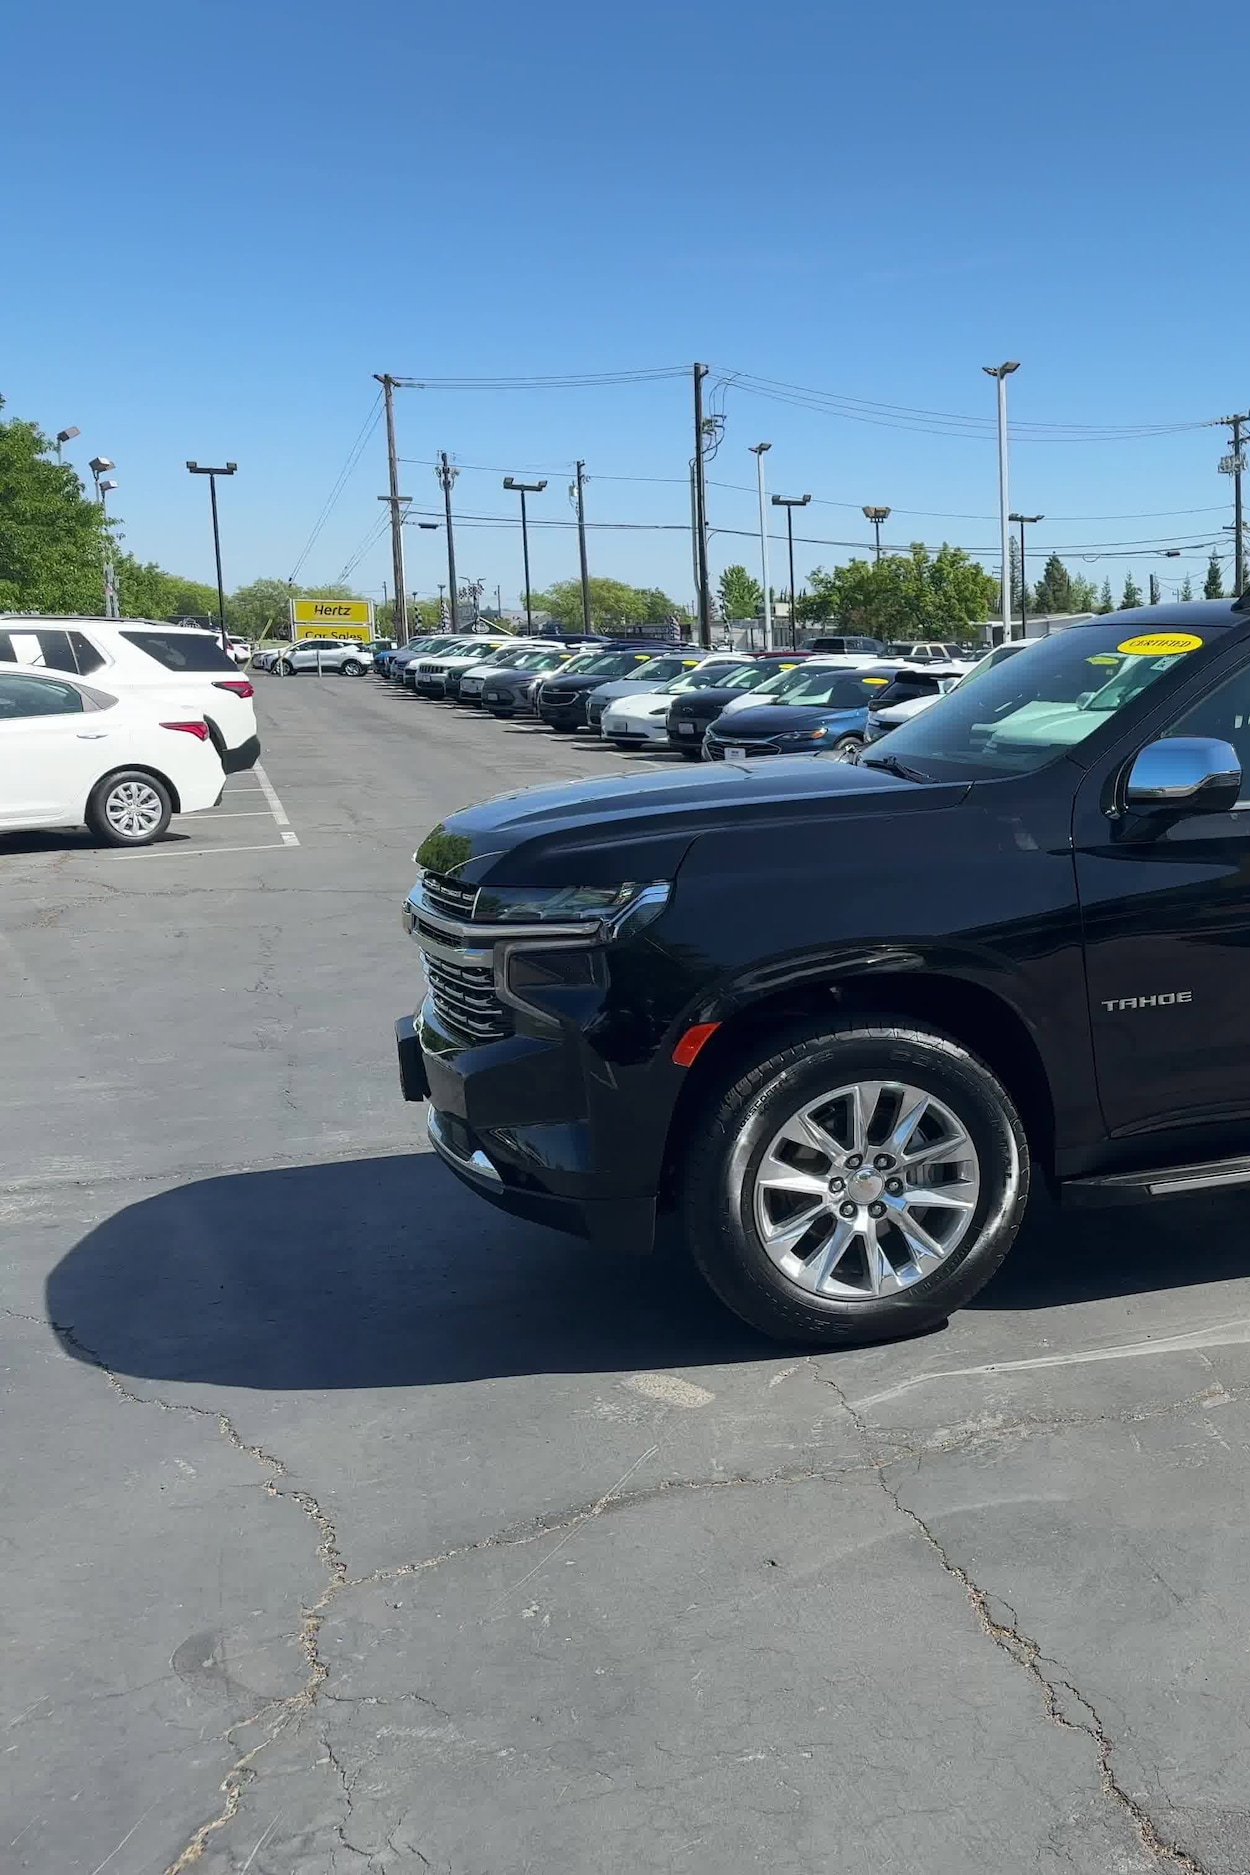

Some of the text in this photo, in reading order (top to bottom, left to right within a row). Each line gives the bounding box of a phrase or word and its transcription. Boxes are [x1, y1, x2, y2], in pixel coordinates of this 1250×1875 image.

[313, 604, 352, 616] Hertz
[1129, 638, 1191, 648] CERTIFIED
[1101, 991, 1193, 1012] TAHOE
